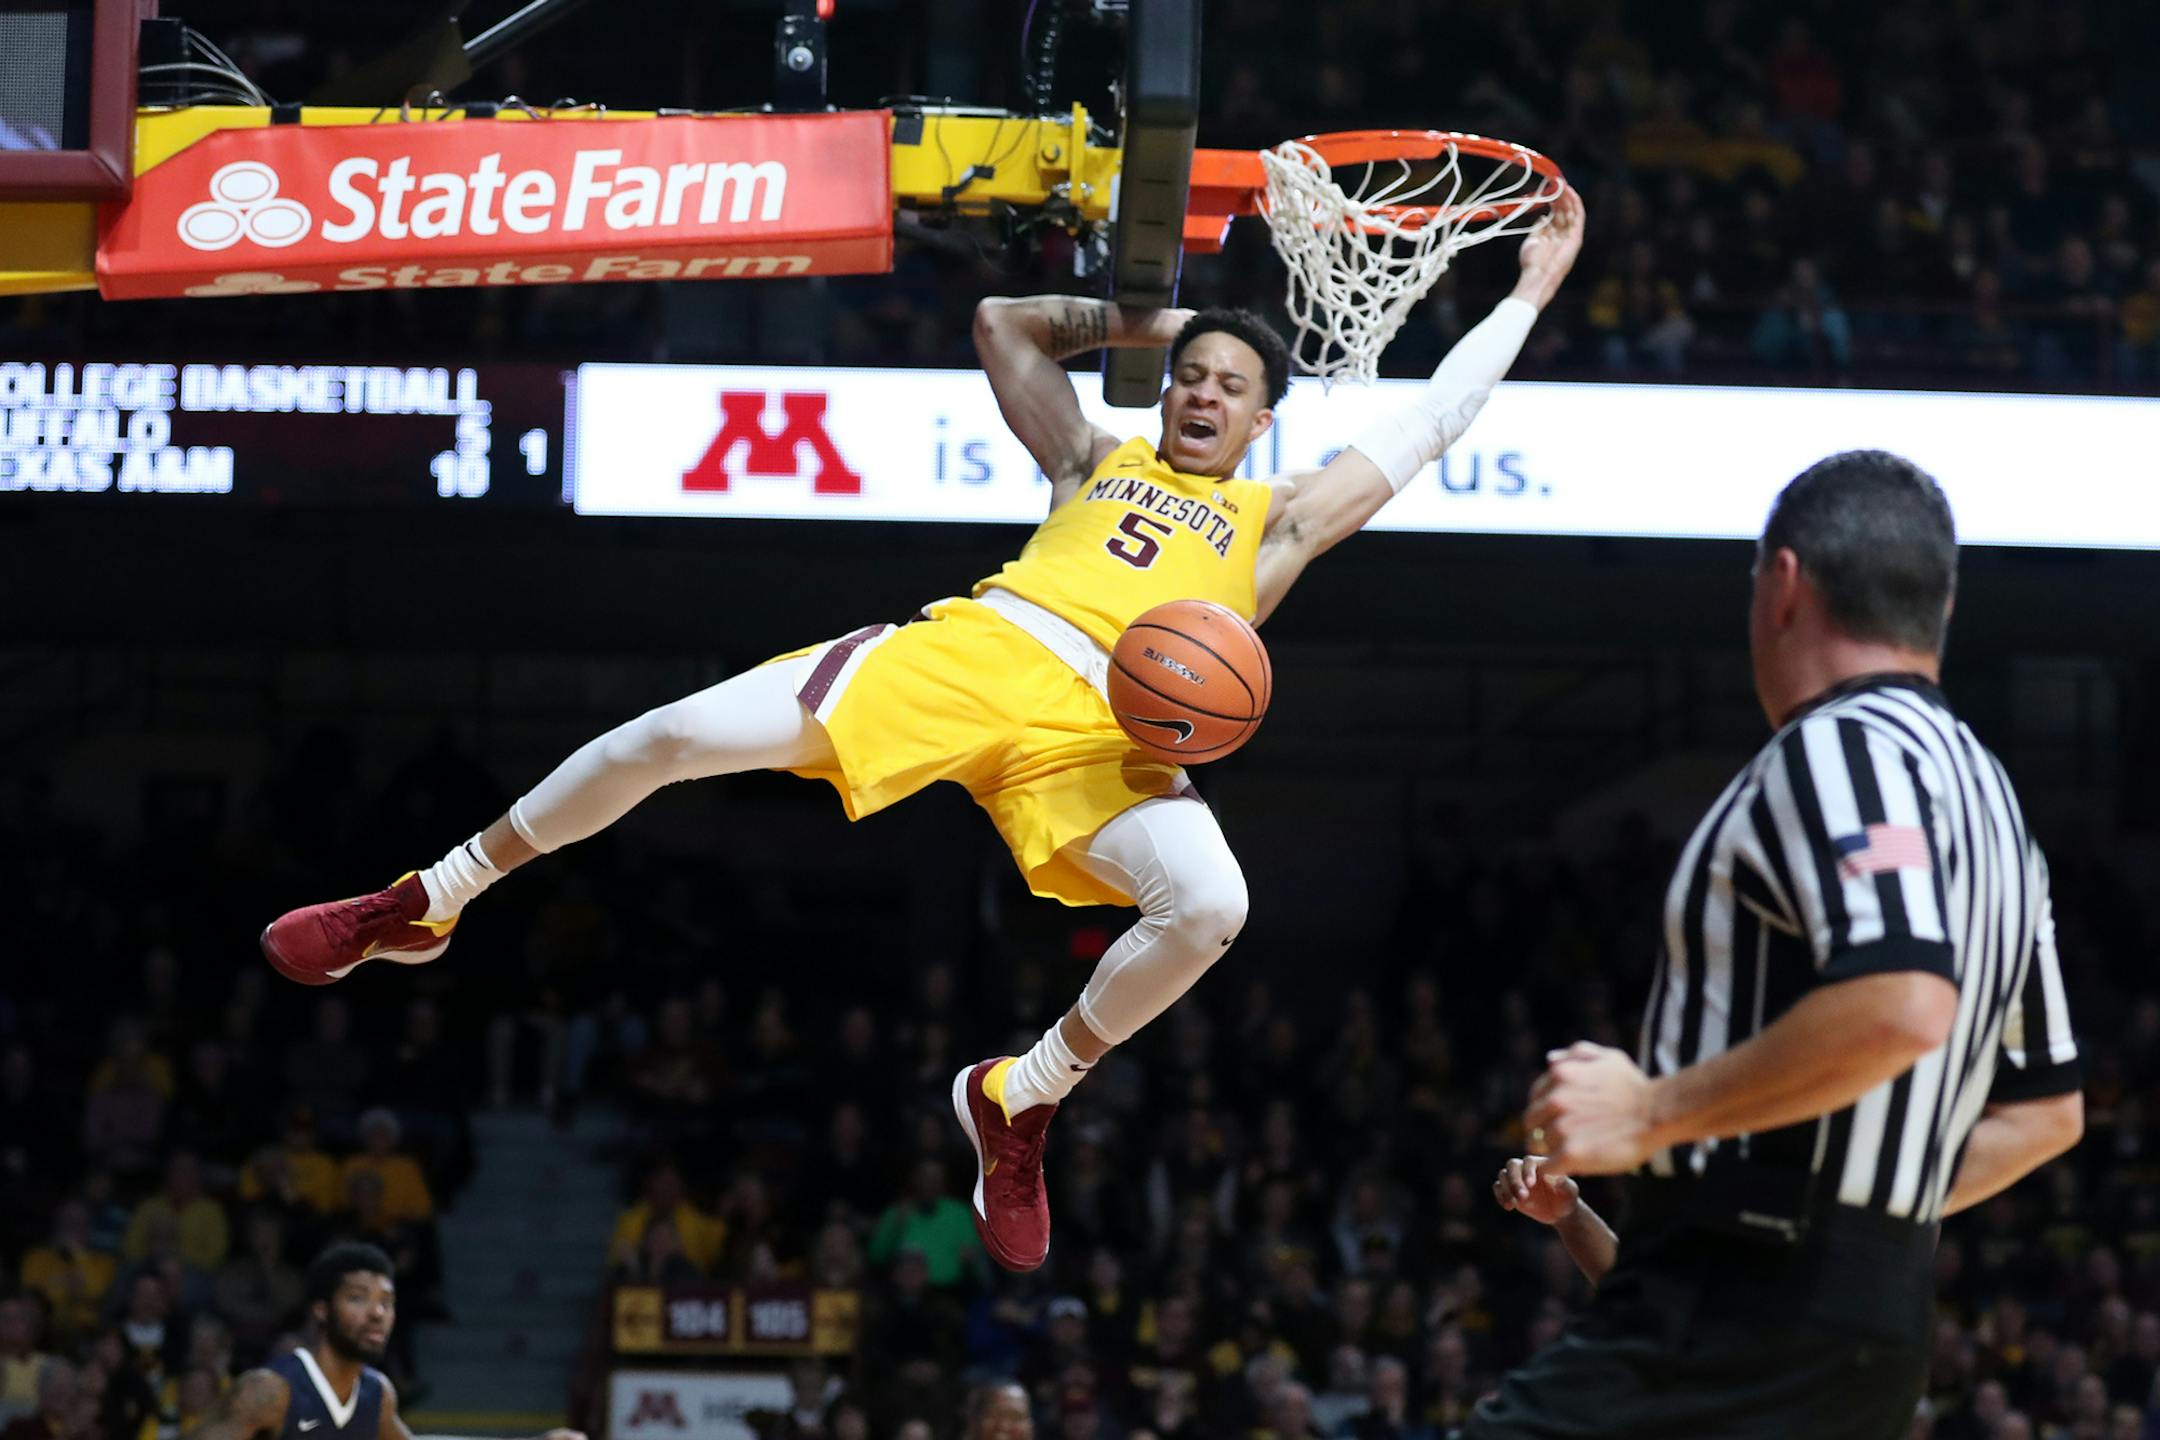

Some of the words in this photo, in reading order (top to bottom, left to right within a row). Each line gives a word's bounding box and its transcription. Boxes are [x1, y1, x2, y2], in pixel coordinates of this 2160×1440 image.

[321, 153, 557, 243] State
[562, 149, 788, 232] Farm
[335, 260, 575, 291] State
[581, 255, 813, 282] Farm
[181, 363, 491, 415] BASKETBALL
[455, 412, 491, 456] 5
[518, 428, 548, 476] 1
[935, 416, 992, 484] is
[1439, 451, 1553, 496] us.
[430, 450, 490, 498] 10
[1086, 479, 1236, 559] MINNESOTA
[1105, 511, 1174, 569] 5
